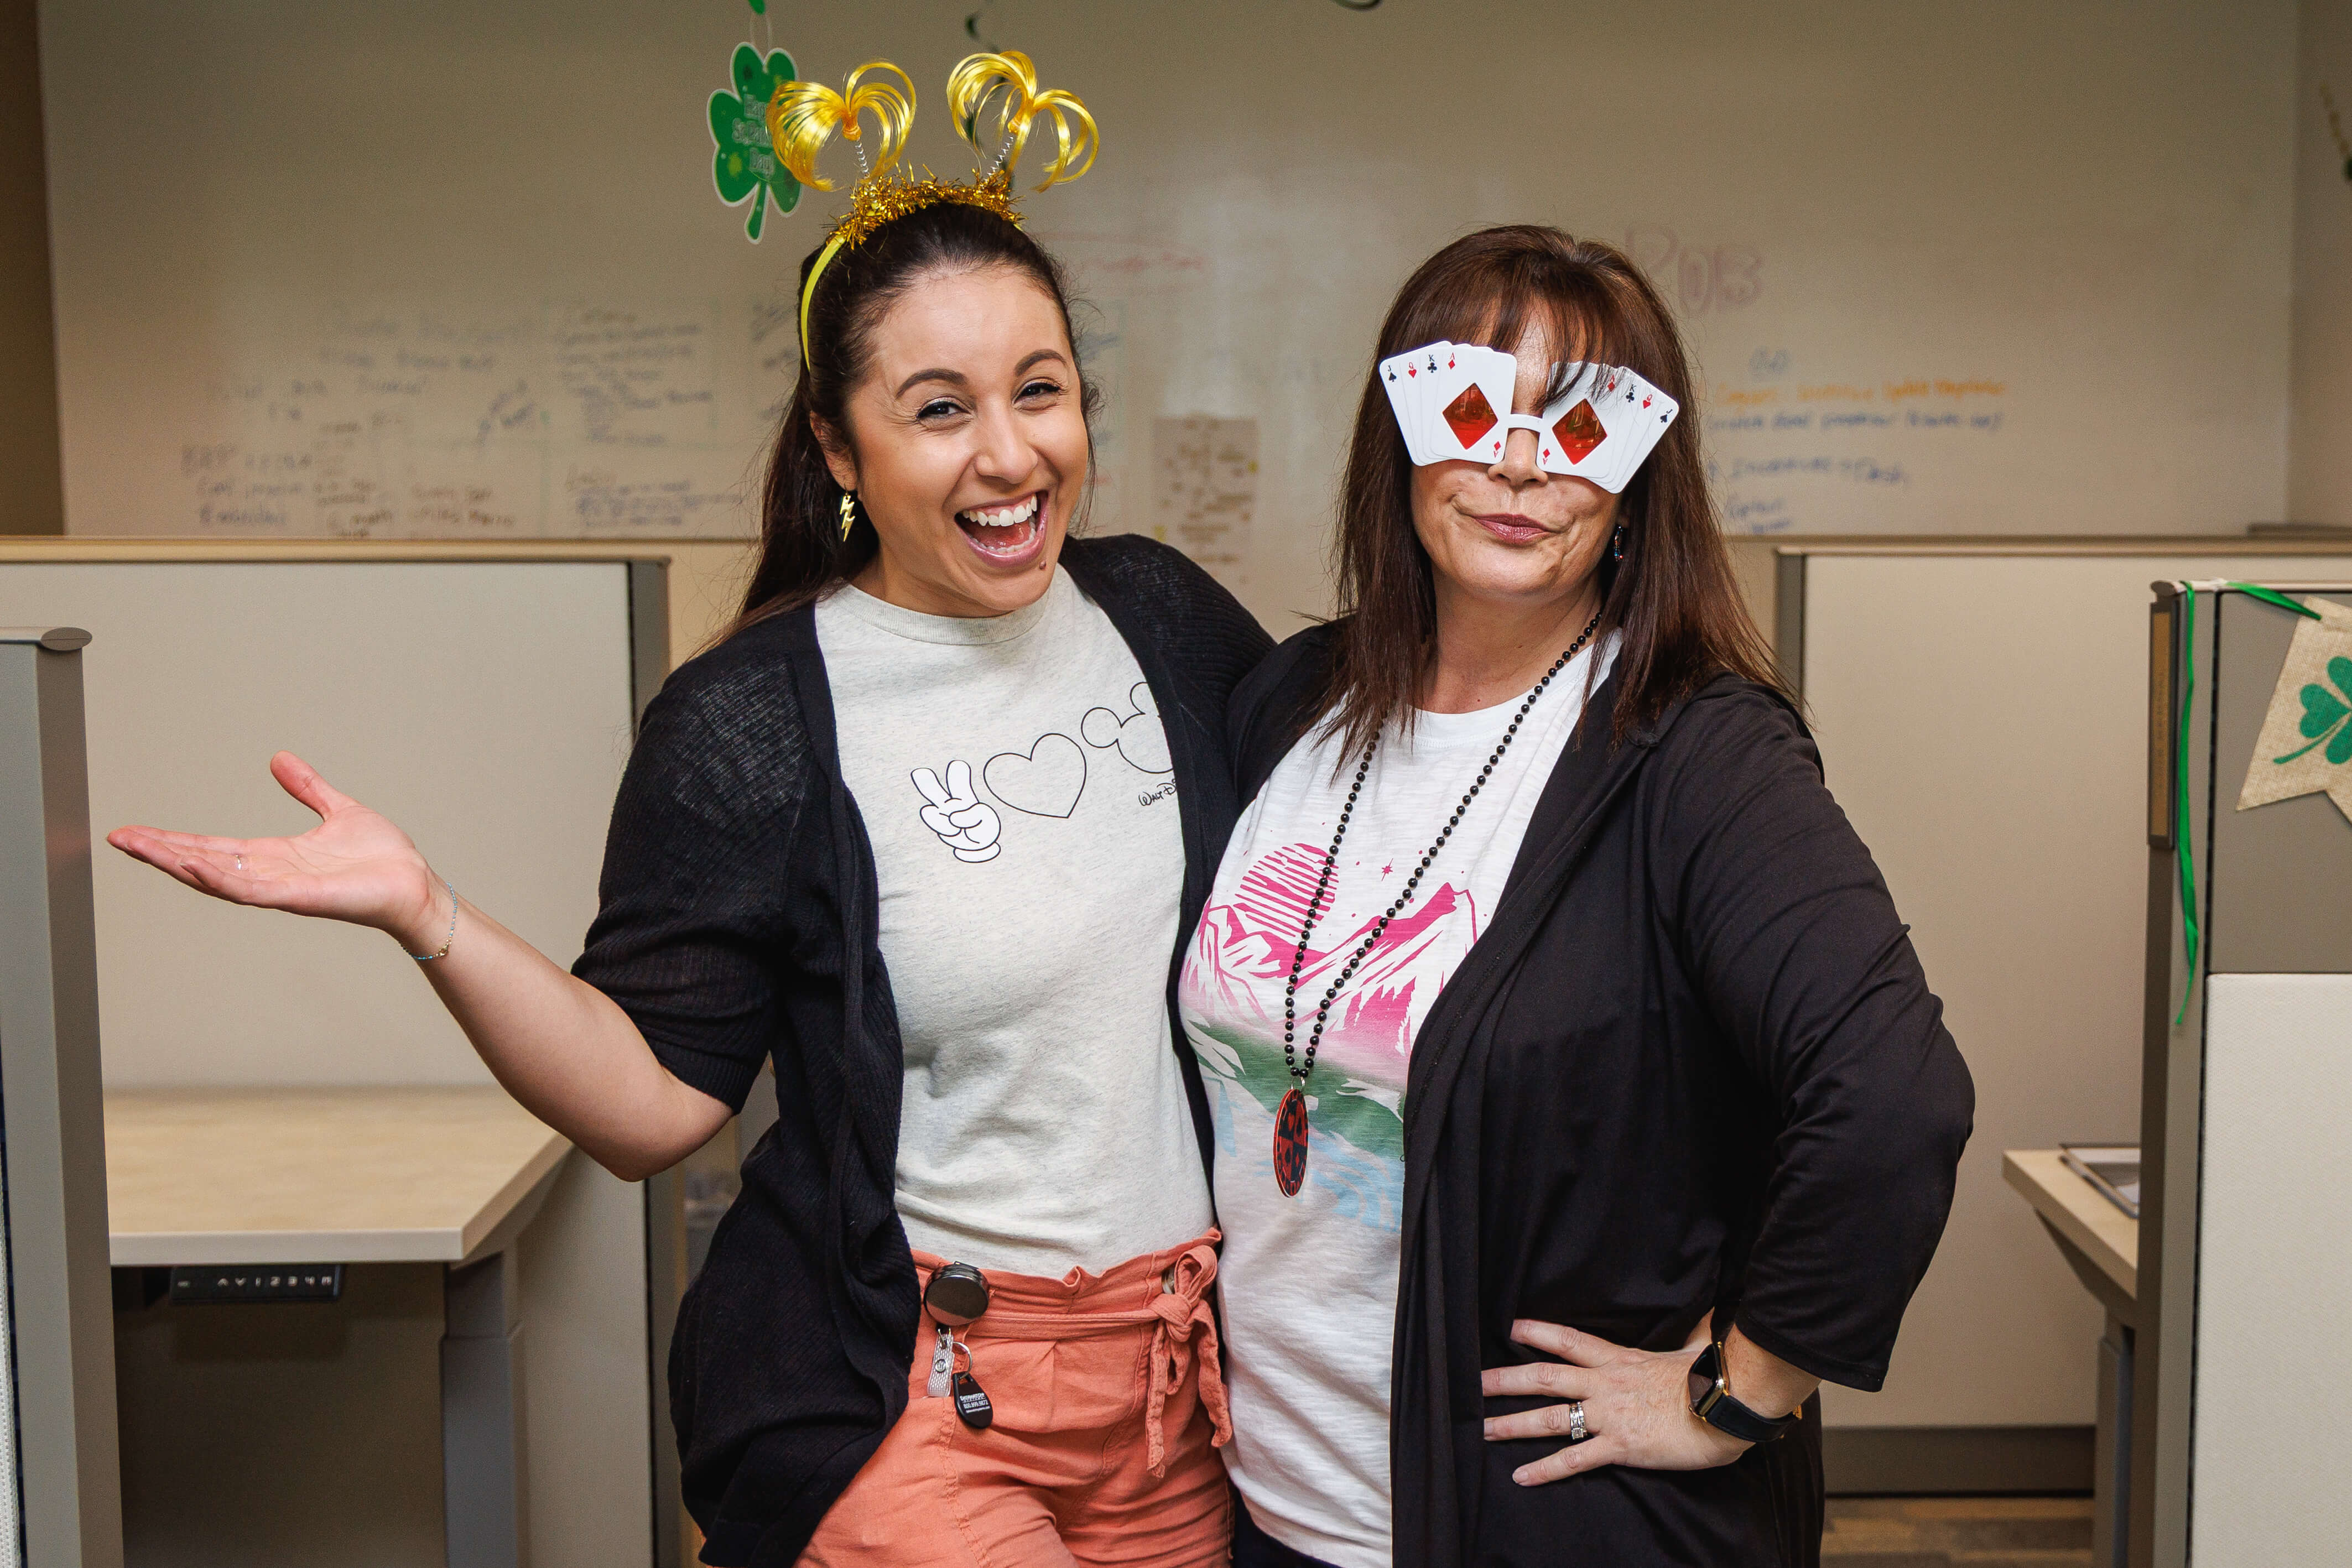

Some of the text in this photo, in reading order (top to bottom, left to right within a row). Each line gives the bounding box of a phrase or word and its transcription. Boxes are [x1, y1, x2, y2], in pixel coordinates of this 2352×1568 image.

[1630, 384, 1637, 392] K
[270, 1276, 280, 1287] 2
[288, 1276, 298, 1287] 3
